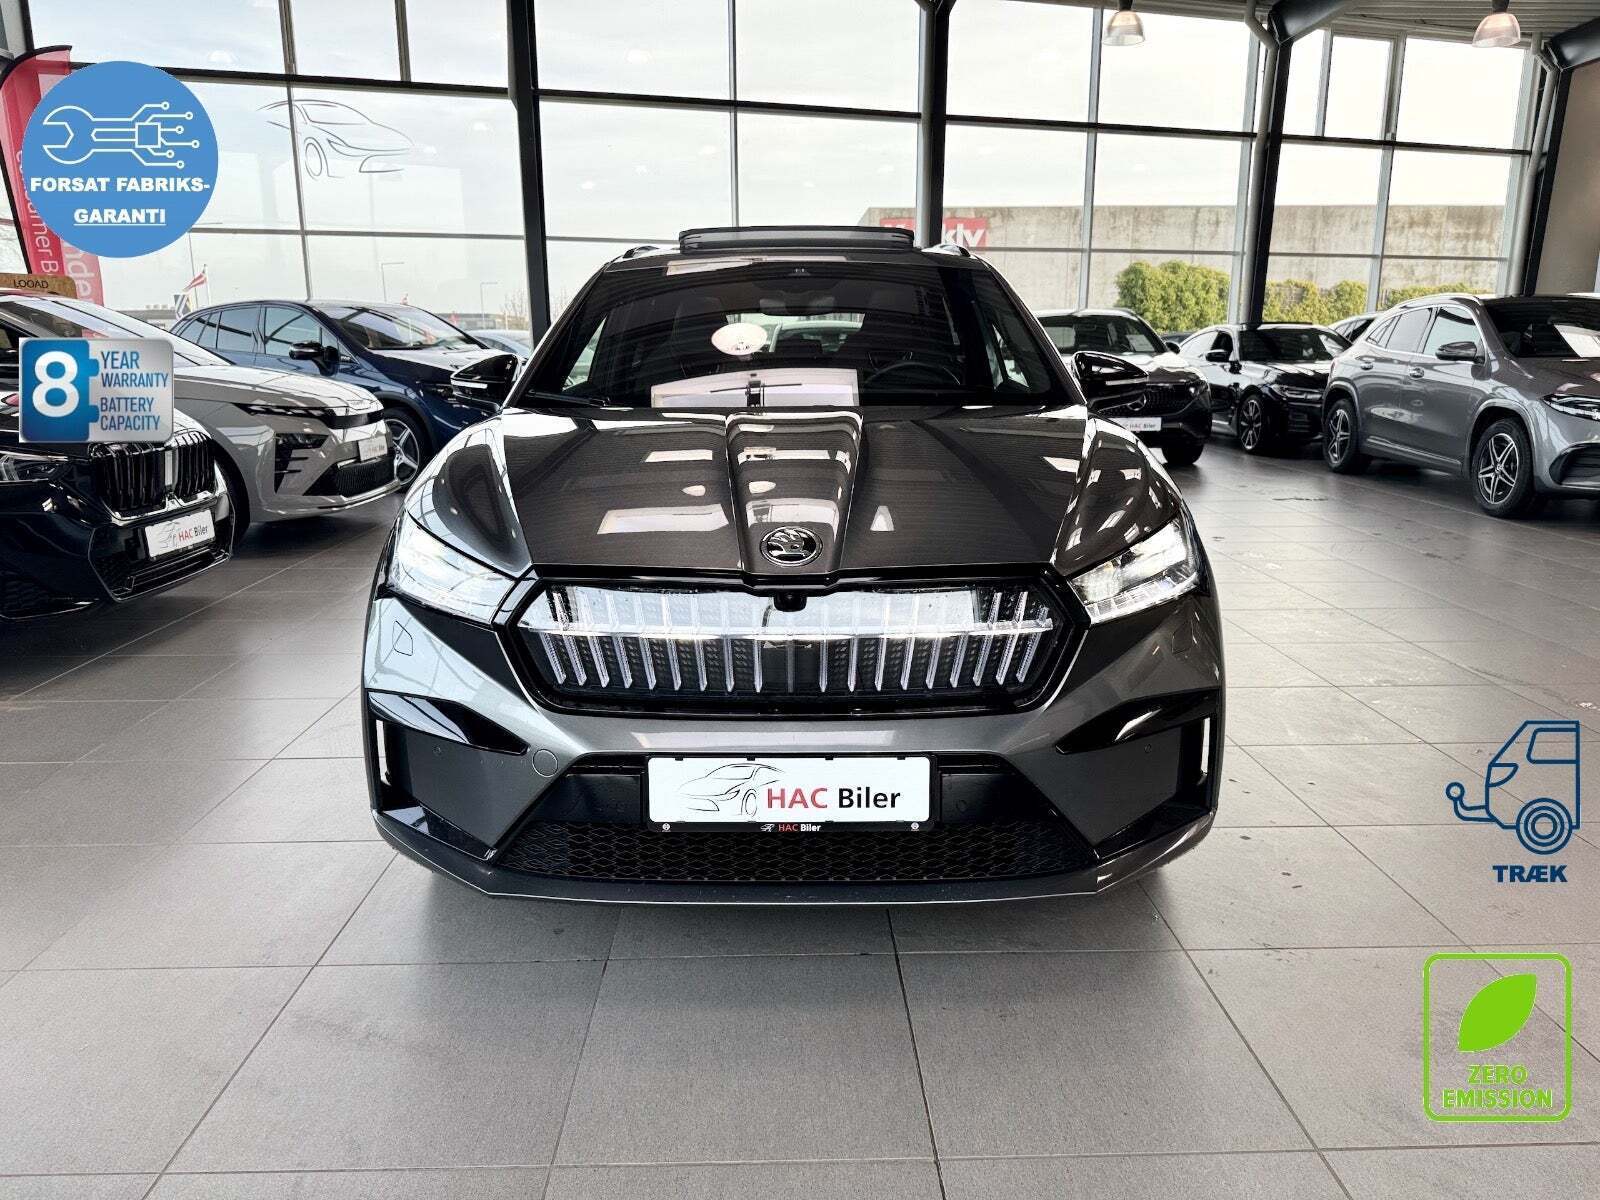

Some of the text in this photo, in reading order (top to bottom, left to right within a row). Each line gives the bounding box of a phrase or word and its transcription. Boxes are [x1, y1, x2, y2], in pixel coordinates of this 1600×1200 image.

[178, 525, 208, 541] HAC Biler
[767, 786, 900, 809] HAC Biler
[778, 823, 821, 832] HAC Biler
